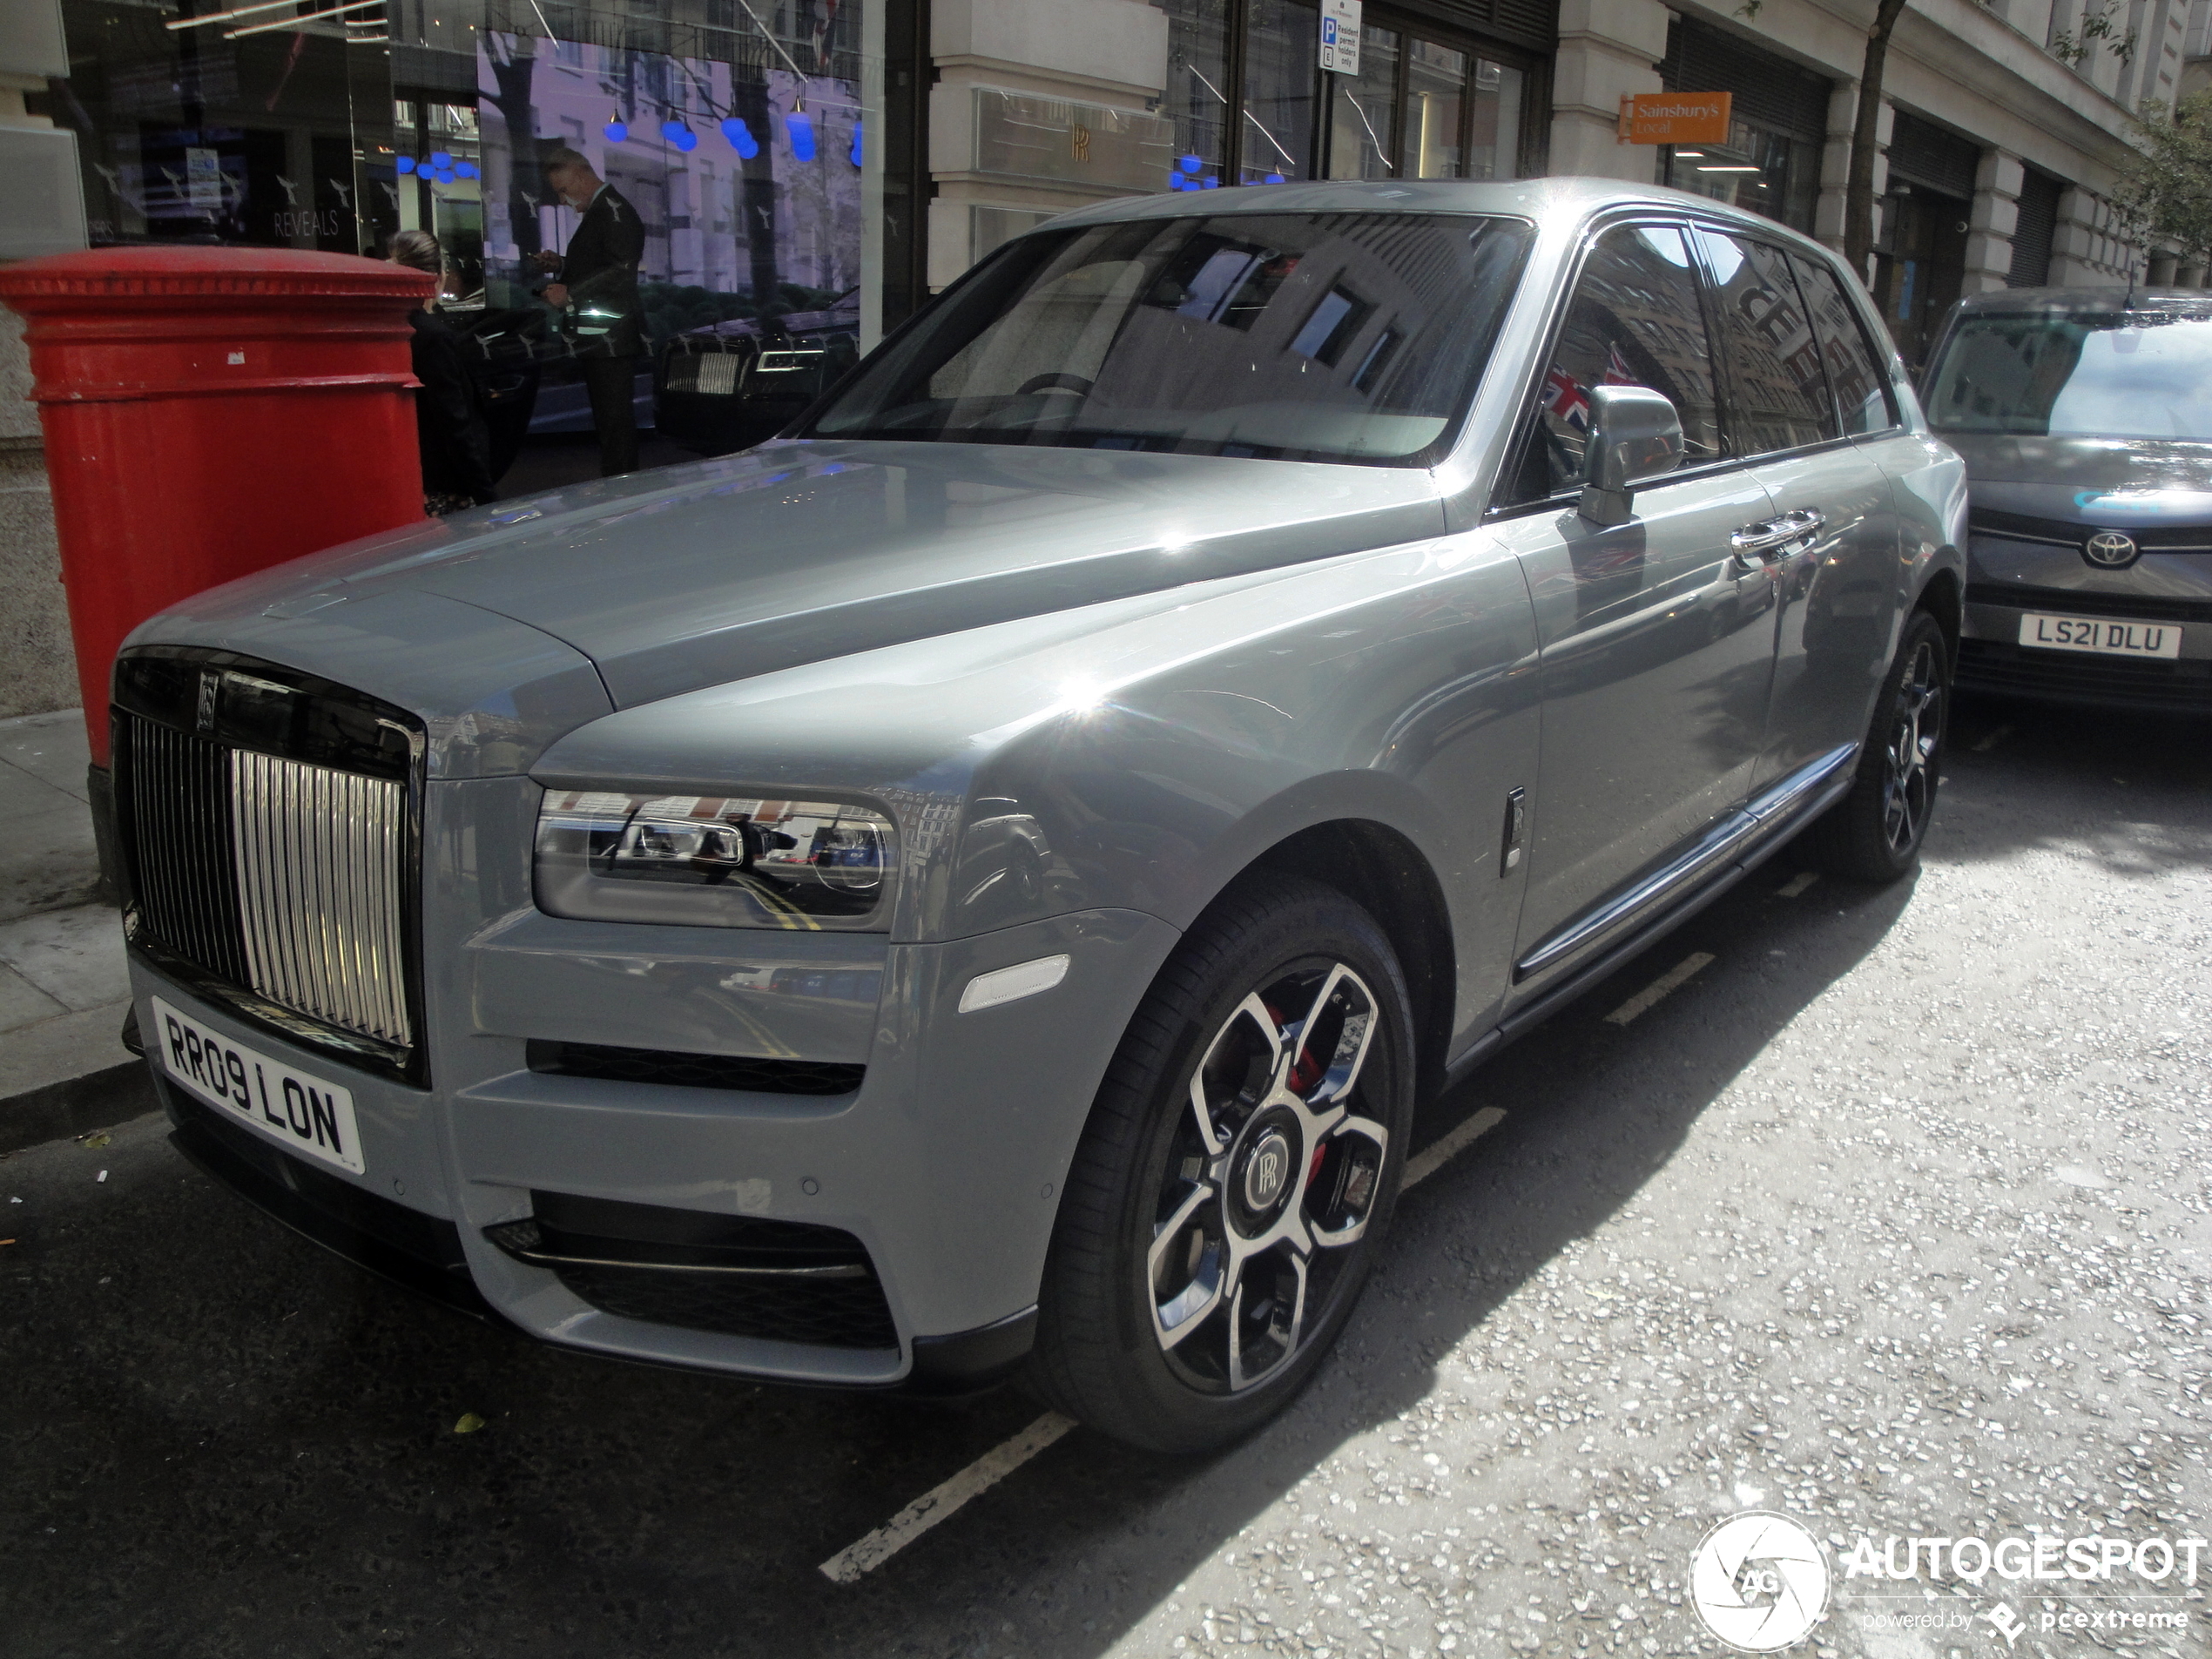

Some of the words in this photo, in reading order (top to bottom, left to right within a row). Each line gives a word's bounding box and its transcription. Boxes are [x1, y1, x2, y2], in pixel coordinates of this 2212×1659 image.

[1326, 20, 1334, 41] P
[1338, 24, 1359, 37] Resident
[1339, 37, 1356, 47] permit
[1338, 45, 1356, 57] holders
[1341, 57, 1352, 67] only
[1638, 104, 1720, 120] Sainsbury's
[1636, 120, 1670, 134] Local
[274, 210, 339, 238] REVEALS
[2038, 619, 2099, 645] LS21
[2107, 625, 2162, 651] DLU
[165, 1013, 251, 1110] RR09
[255, 1062, 342, 1155] LON
